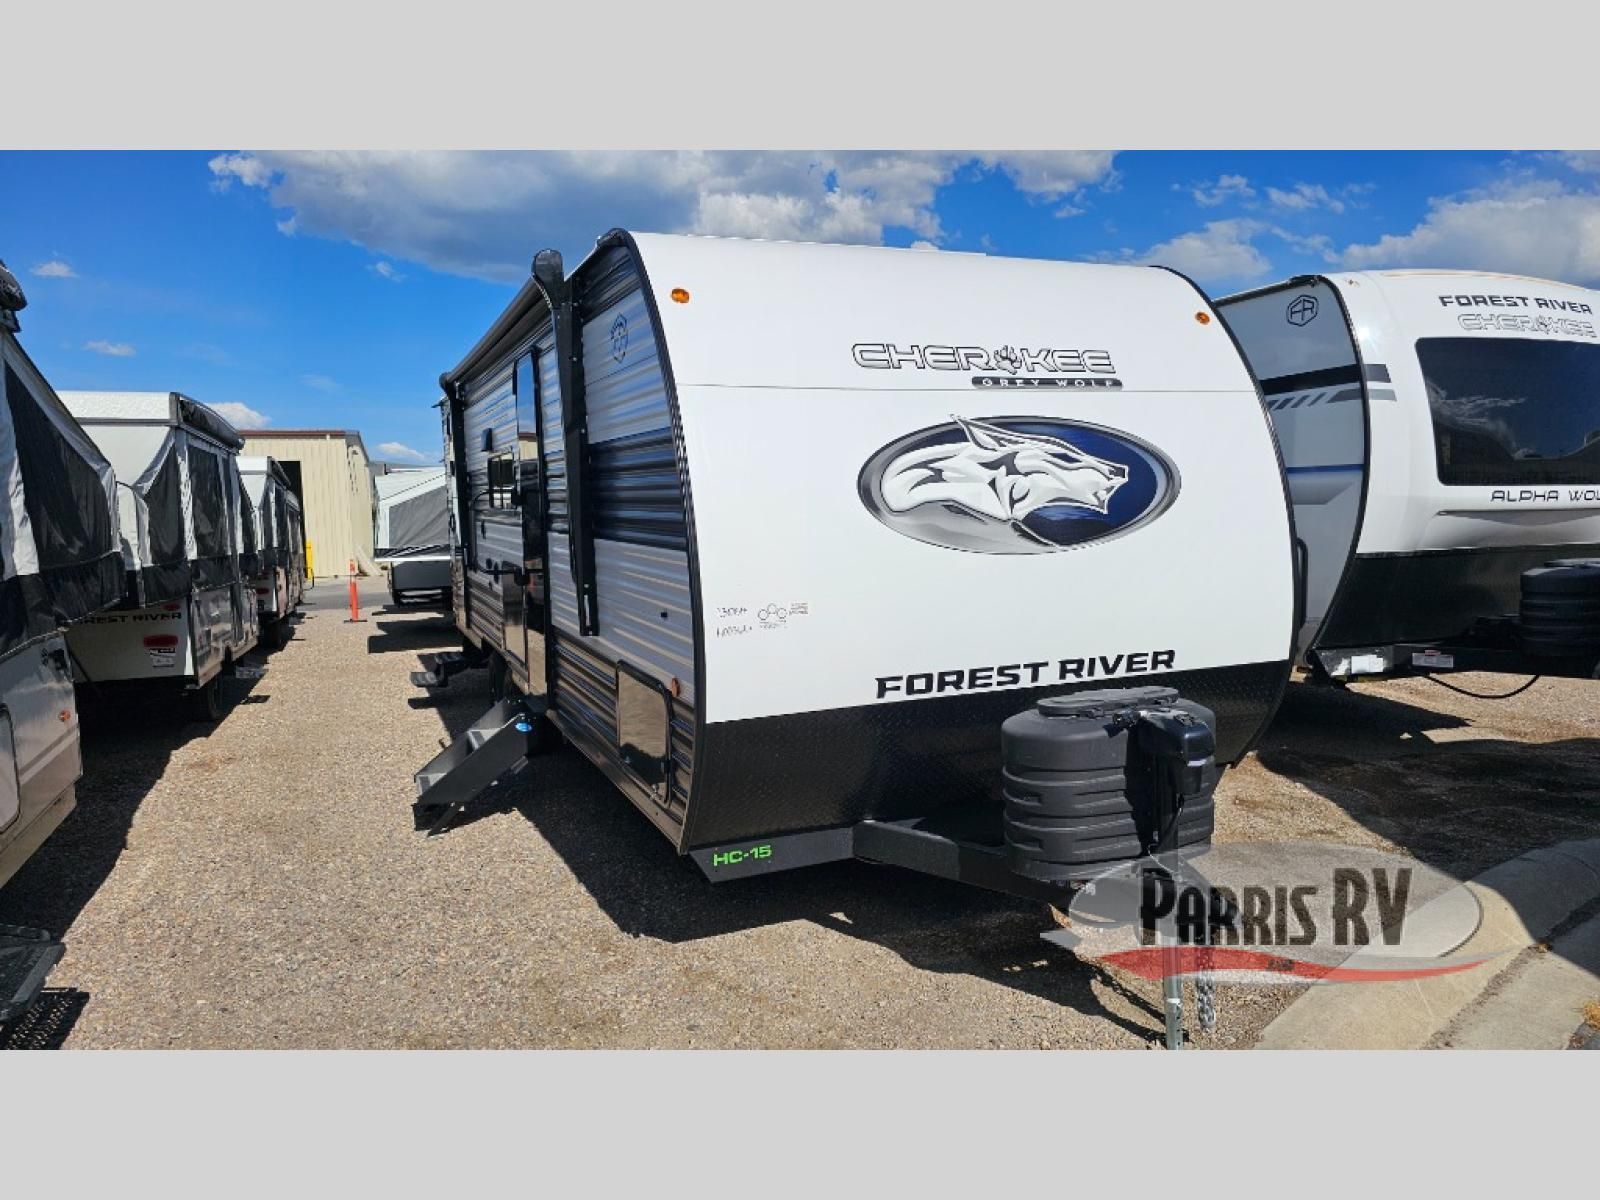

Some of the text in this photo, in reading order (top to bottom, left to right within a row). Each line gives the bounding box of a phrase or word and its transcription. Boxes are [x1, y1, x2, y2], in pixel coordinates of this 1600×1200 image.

[1438, 294, 1593, 315] FOREST RIVER
[851, 343, 1117, 374] CHEROKEE
[982, 377, 1115, 388] GREY WOLF
[1489, 490, 1560, 502] ALPHA
[132, 611, 182, 622] RIVER
[875, 649, 1176, 699] FOREST RIVER
[713, 845, 772, 866] HC-15
